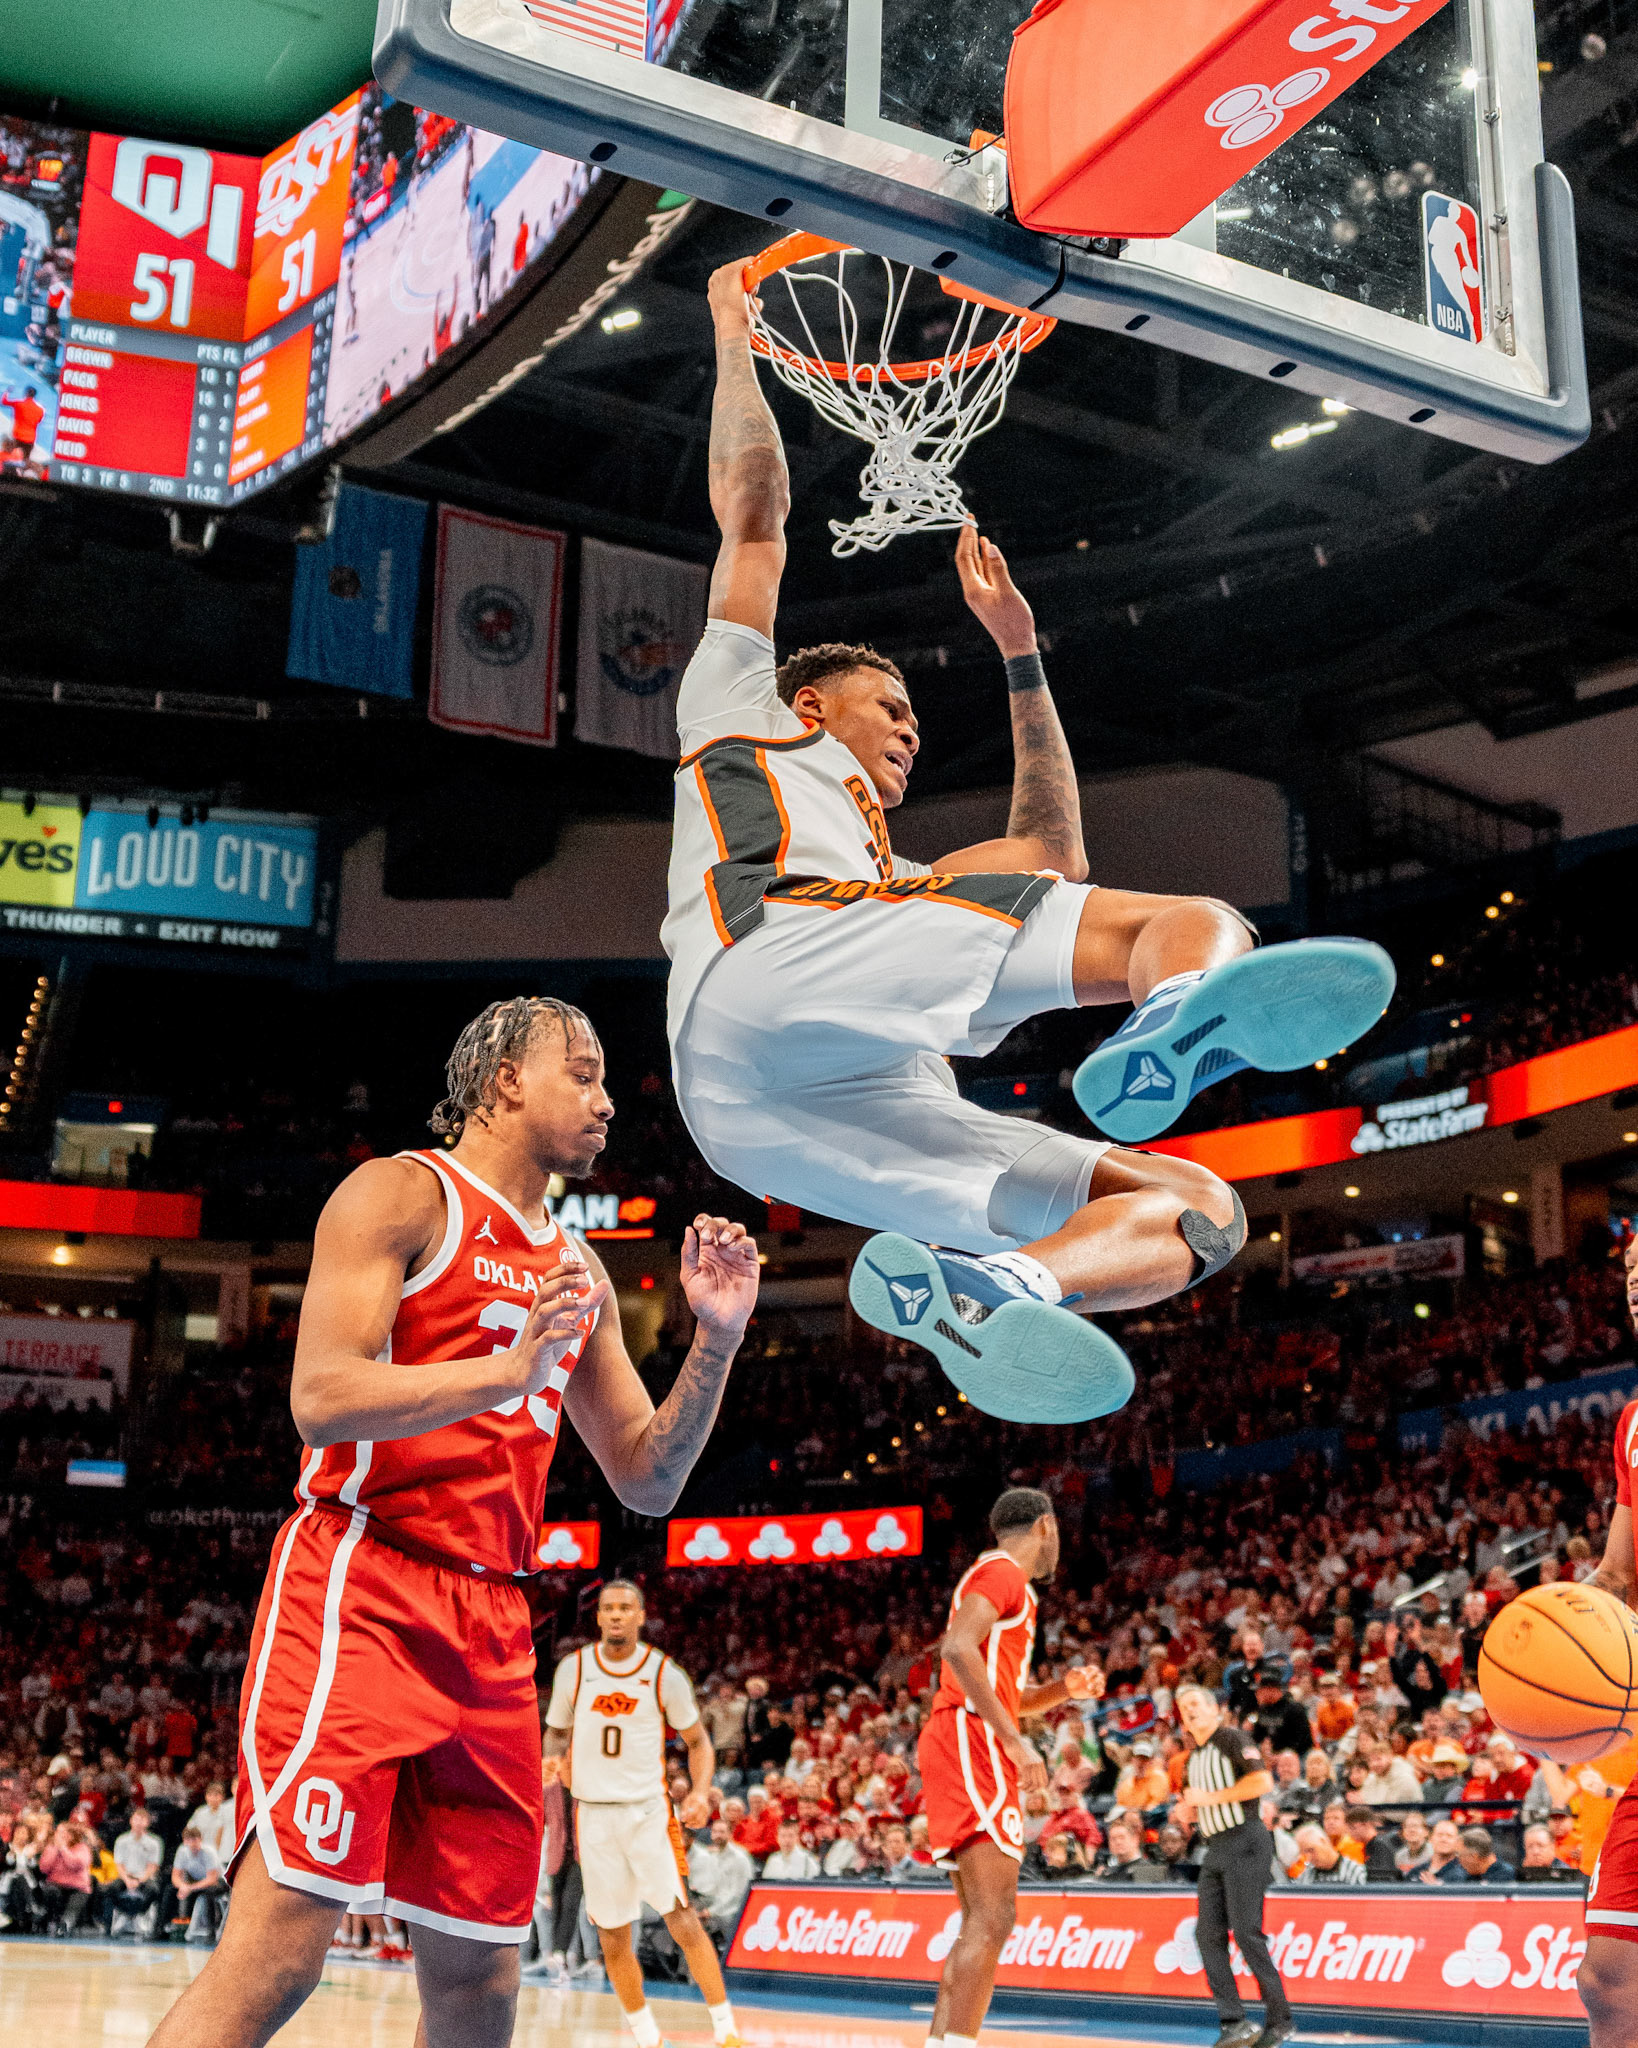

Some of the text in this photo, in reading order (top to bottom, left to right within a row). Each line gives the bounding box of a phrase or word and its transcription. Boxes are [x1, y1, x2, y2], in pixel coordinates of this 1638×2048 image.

[1288, 0, 1421, 62] St
[278, 229, 316, 312] 51
[130, 253, 194, 327] 51
[1437, 303, 1464, 334] NBA
[66, 346, 113, 369] BROWN
[71, 324, 240, 364] PLAYER PTS FL
[63, 369, 98, 390] PACK
[59, 393, 99, 414] JONES
[57, 416, 95, 436] DAVIS
[54, 439, 87, 459] REID
[149, 478, 175, 496] 2ND
[87, 830, 199, 896] LOUD
[214, 834, 306, 910] CITY
[3, 908, 280, 948] THUNDER EXIT NOW
[474, 1256, 543, 1297] OKLA
[591, 1692, 640, 1717] OSU
[602, 1725, 622, 1758] 0
[293, 1776, 356, 1866] OU
